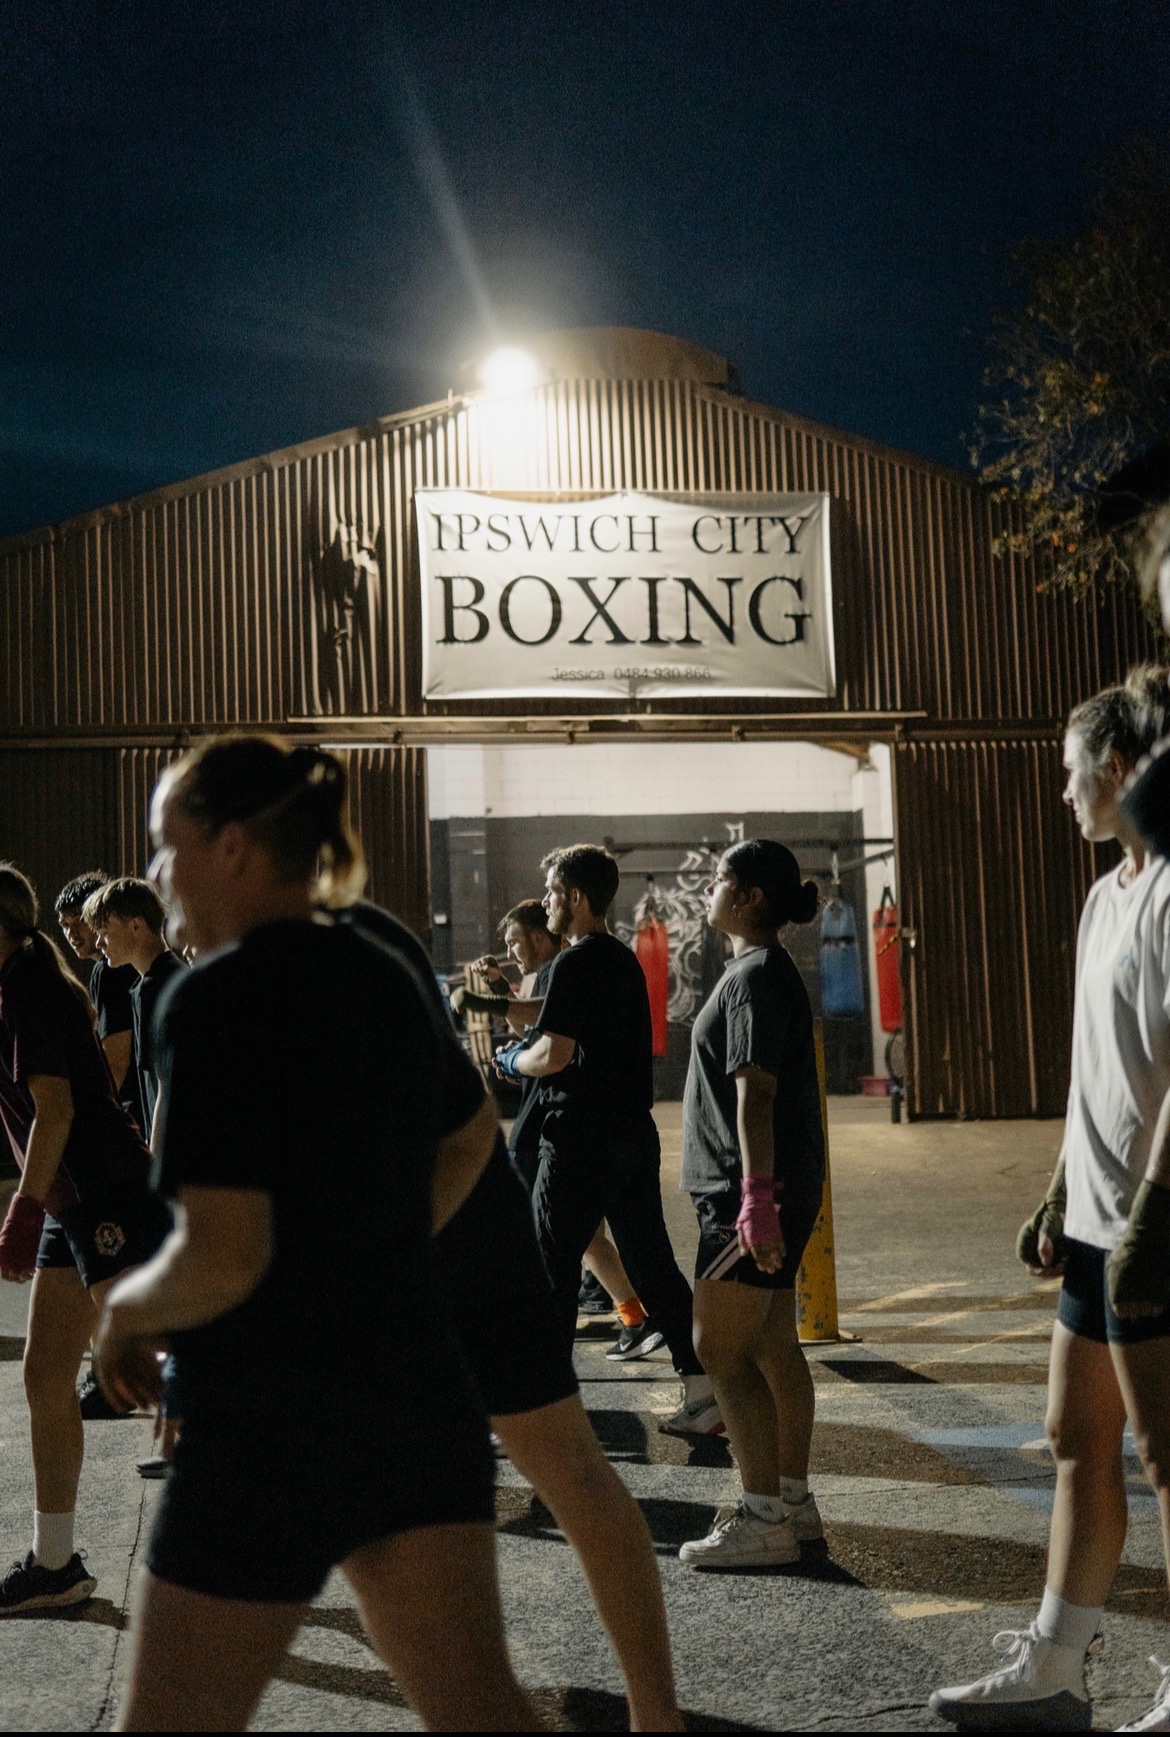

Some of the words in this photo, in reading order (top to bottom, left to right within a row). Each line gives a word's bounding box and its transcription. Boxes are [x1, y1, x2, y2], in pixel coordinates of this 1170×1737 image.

[432, 513, 663, 553] IPSWICH
[691, 514, 809, 554] CITY
[435, 574, 813, 647] BOXING
[552, 668, 605, 680] Jessica
[614, 667, 650, 680] 0484
